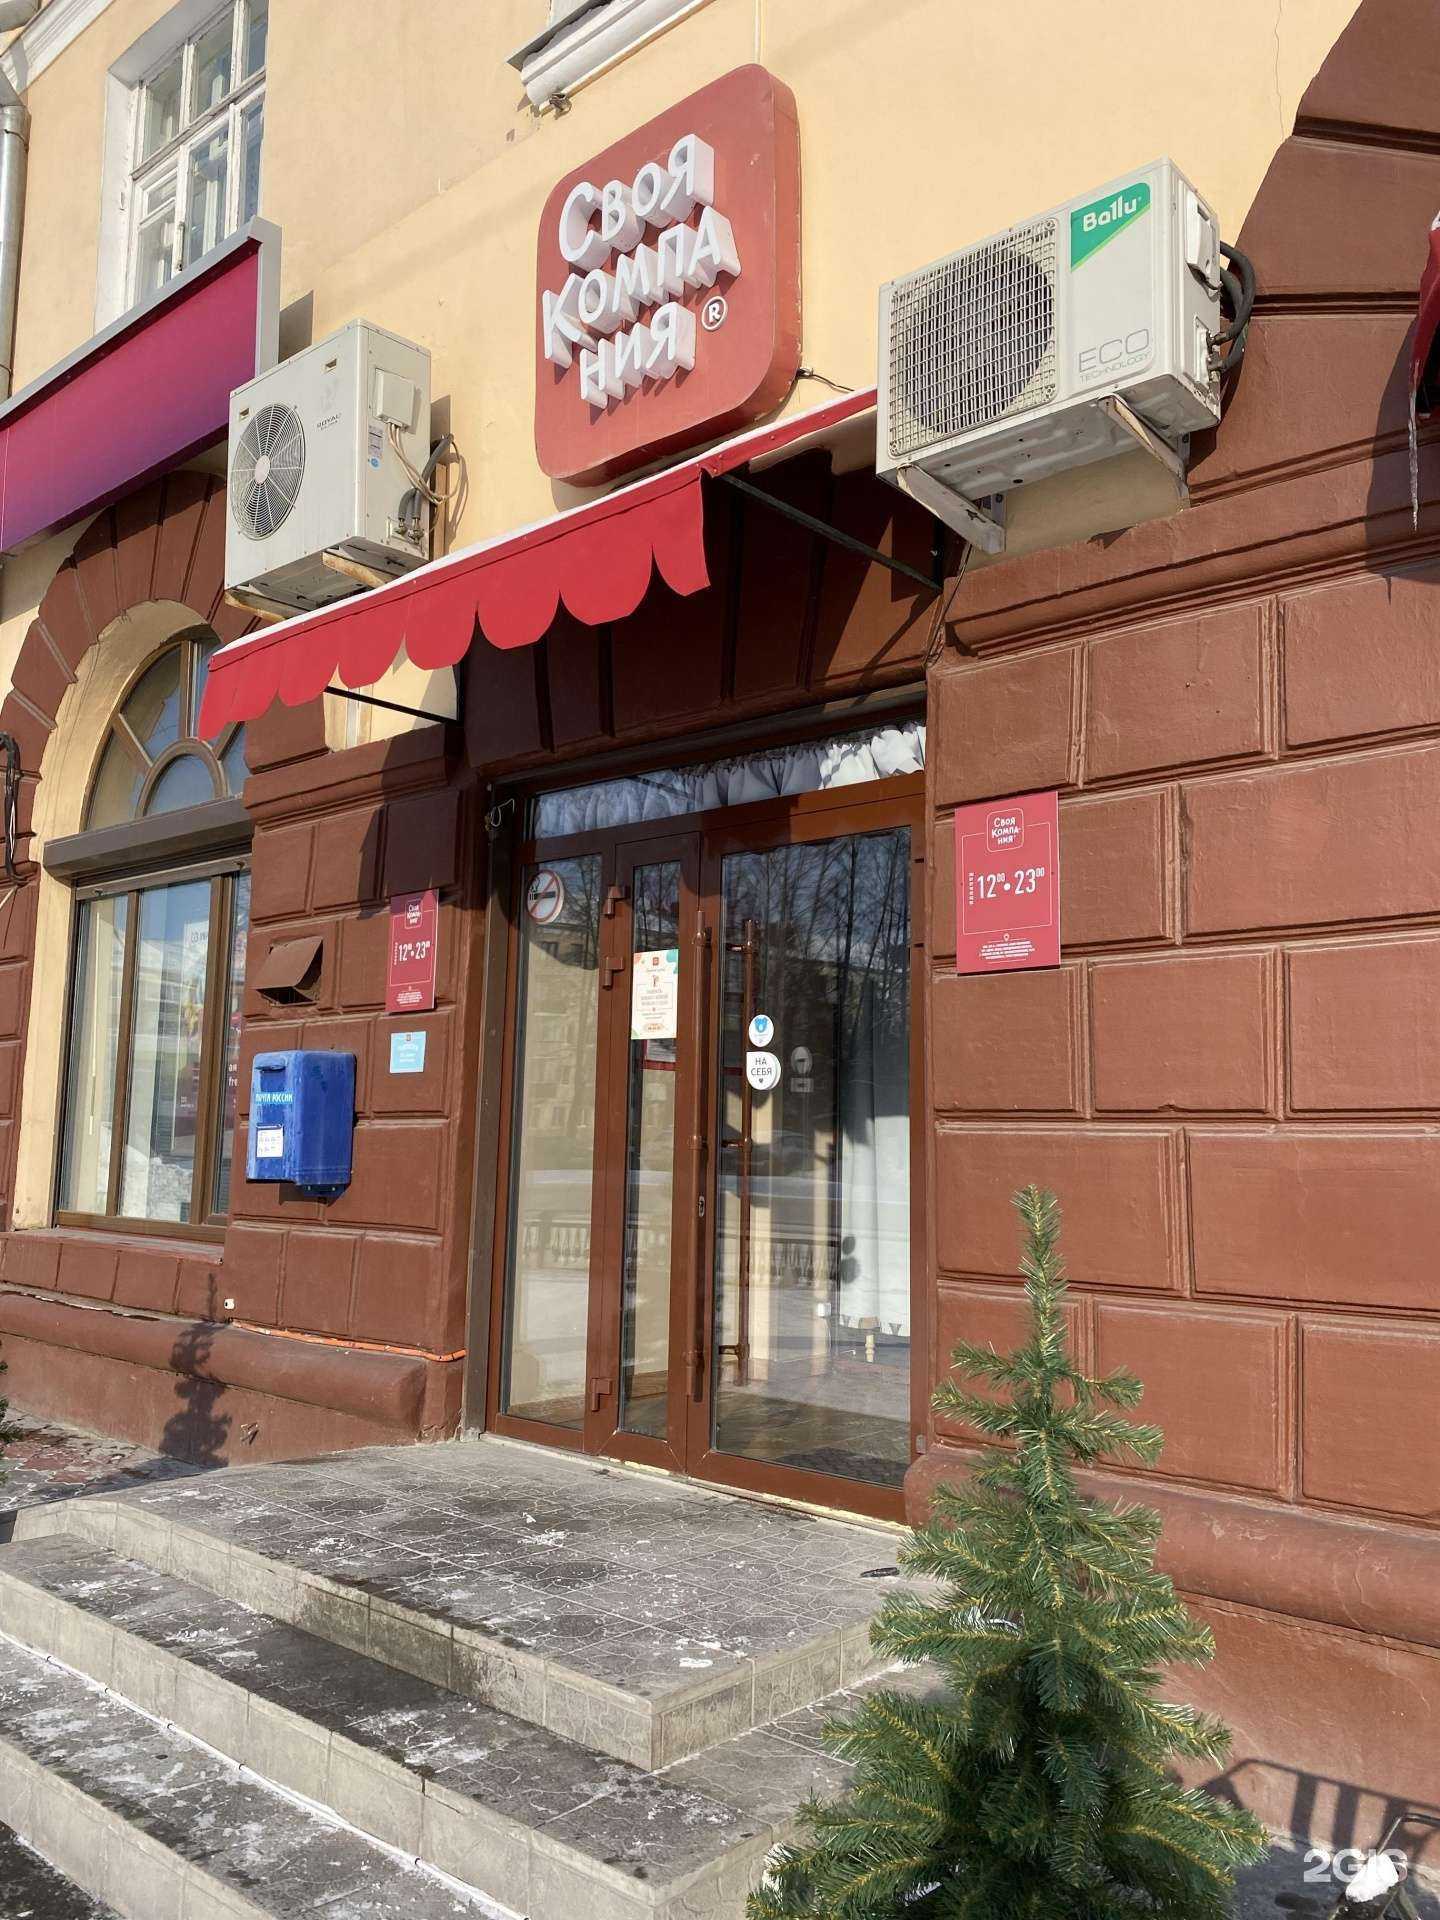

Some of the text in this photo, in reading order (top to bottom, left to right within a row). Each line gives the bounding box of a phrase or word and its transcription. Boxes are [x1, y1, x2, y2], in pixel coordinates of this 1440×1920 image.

[1083, 195, 1137, 232] Ballu
[543, 206, 741, 367] КОМПА
[580, 301, 696, 409] НИЯ
[1079, 328, 1149, 373] ECO
[750, 1067, 772, 1076] СЕБЯ
[755, 1057, 767, 1065] НА
